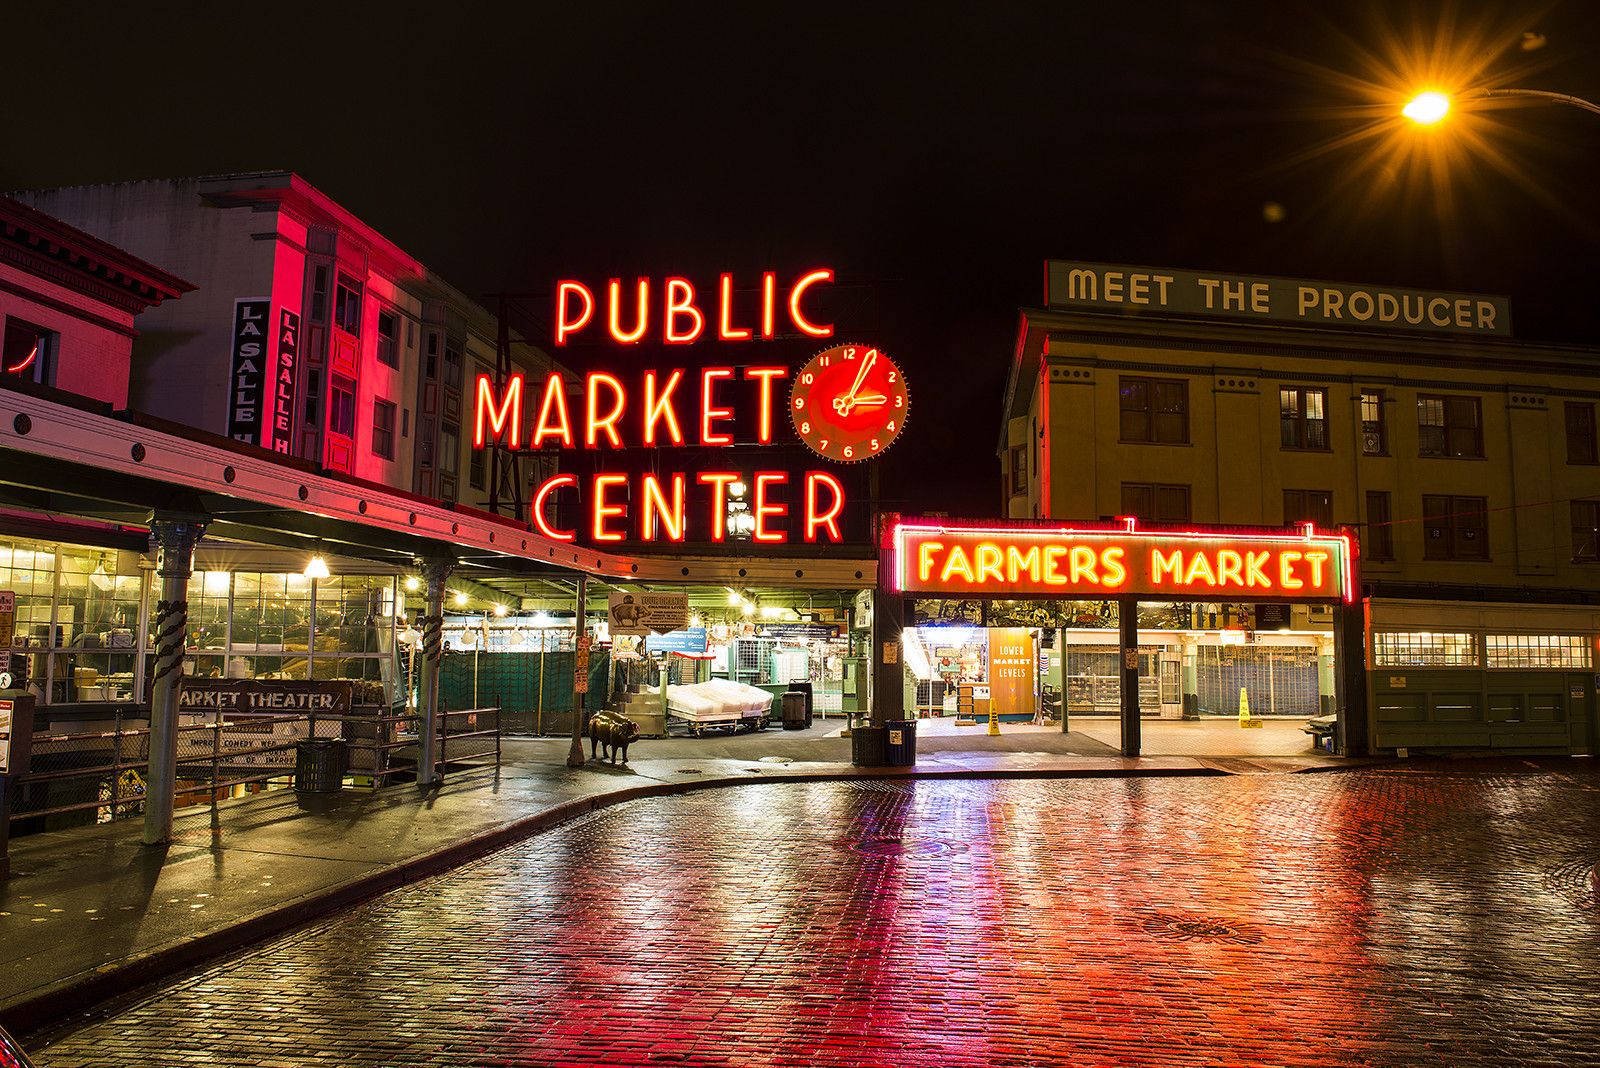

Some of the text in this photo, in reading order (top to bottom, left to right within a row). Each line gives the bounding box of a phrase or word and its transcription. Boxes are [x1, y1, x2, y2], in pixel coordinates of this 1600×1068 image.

[1069, 269, 1497, 329] MEET THE PRODUCER
[554, 268, 834, 346] PUBLIC
[240, 307, 262, 335] LA
[283, 314, 295, 346] LA
[843, 348, 856, 360] 12
[819, 356, 829, 367] 11
[235, 343, 260, 422] SALLE
[801, 373, 814, 385] 10
[888, 371, 897, 383] 2
[277, 353, 293, 431] SALLE
[473, 366, 788, 450] MARKET
[795, 397, 805, 410] 9
[895, 395, 903, 408] 3
[801, 421, 811, 434] 8
[886, 420, 896, 432] 4
[820, 440, 829, 451] 7
[870, 439, 879, 451] 5
[843, 446, 853, 458] 6
[532, 471, 846, 544] CENTER
[919, 541, 1328, 589] FARMERS MARKET
[1000, 646, 1024, 655] LOWER
[999, 668, 1025, 677] LEVELS
[179, 690, 332, 709] ARKET THEATER
